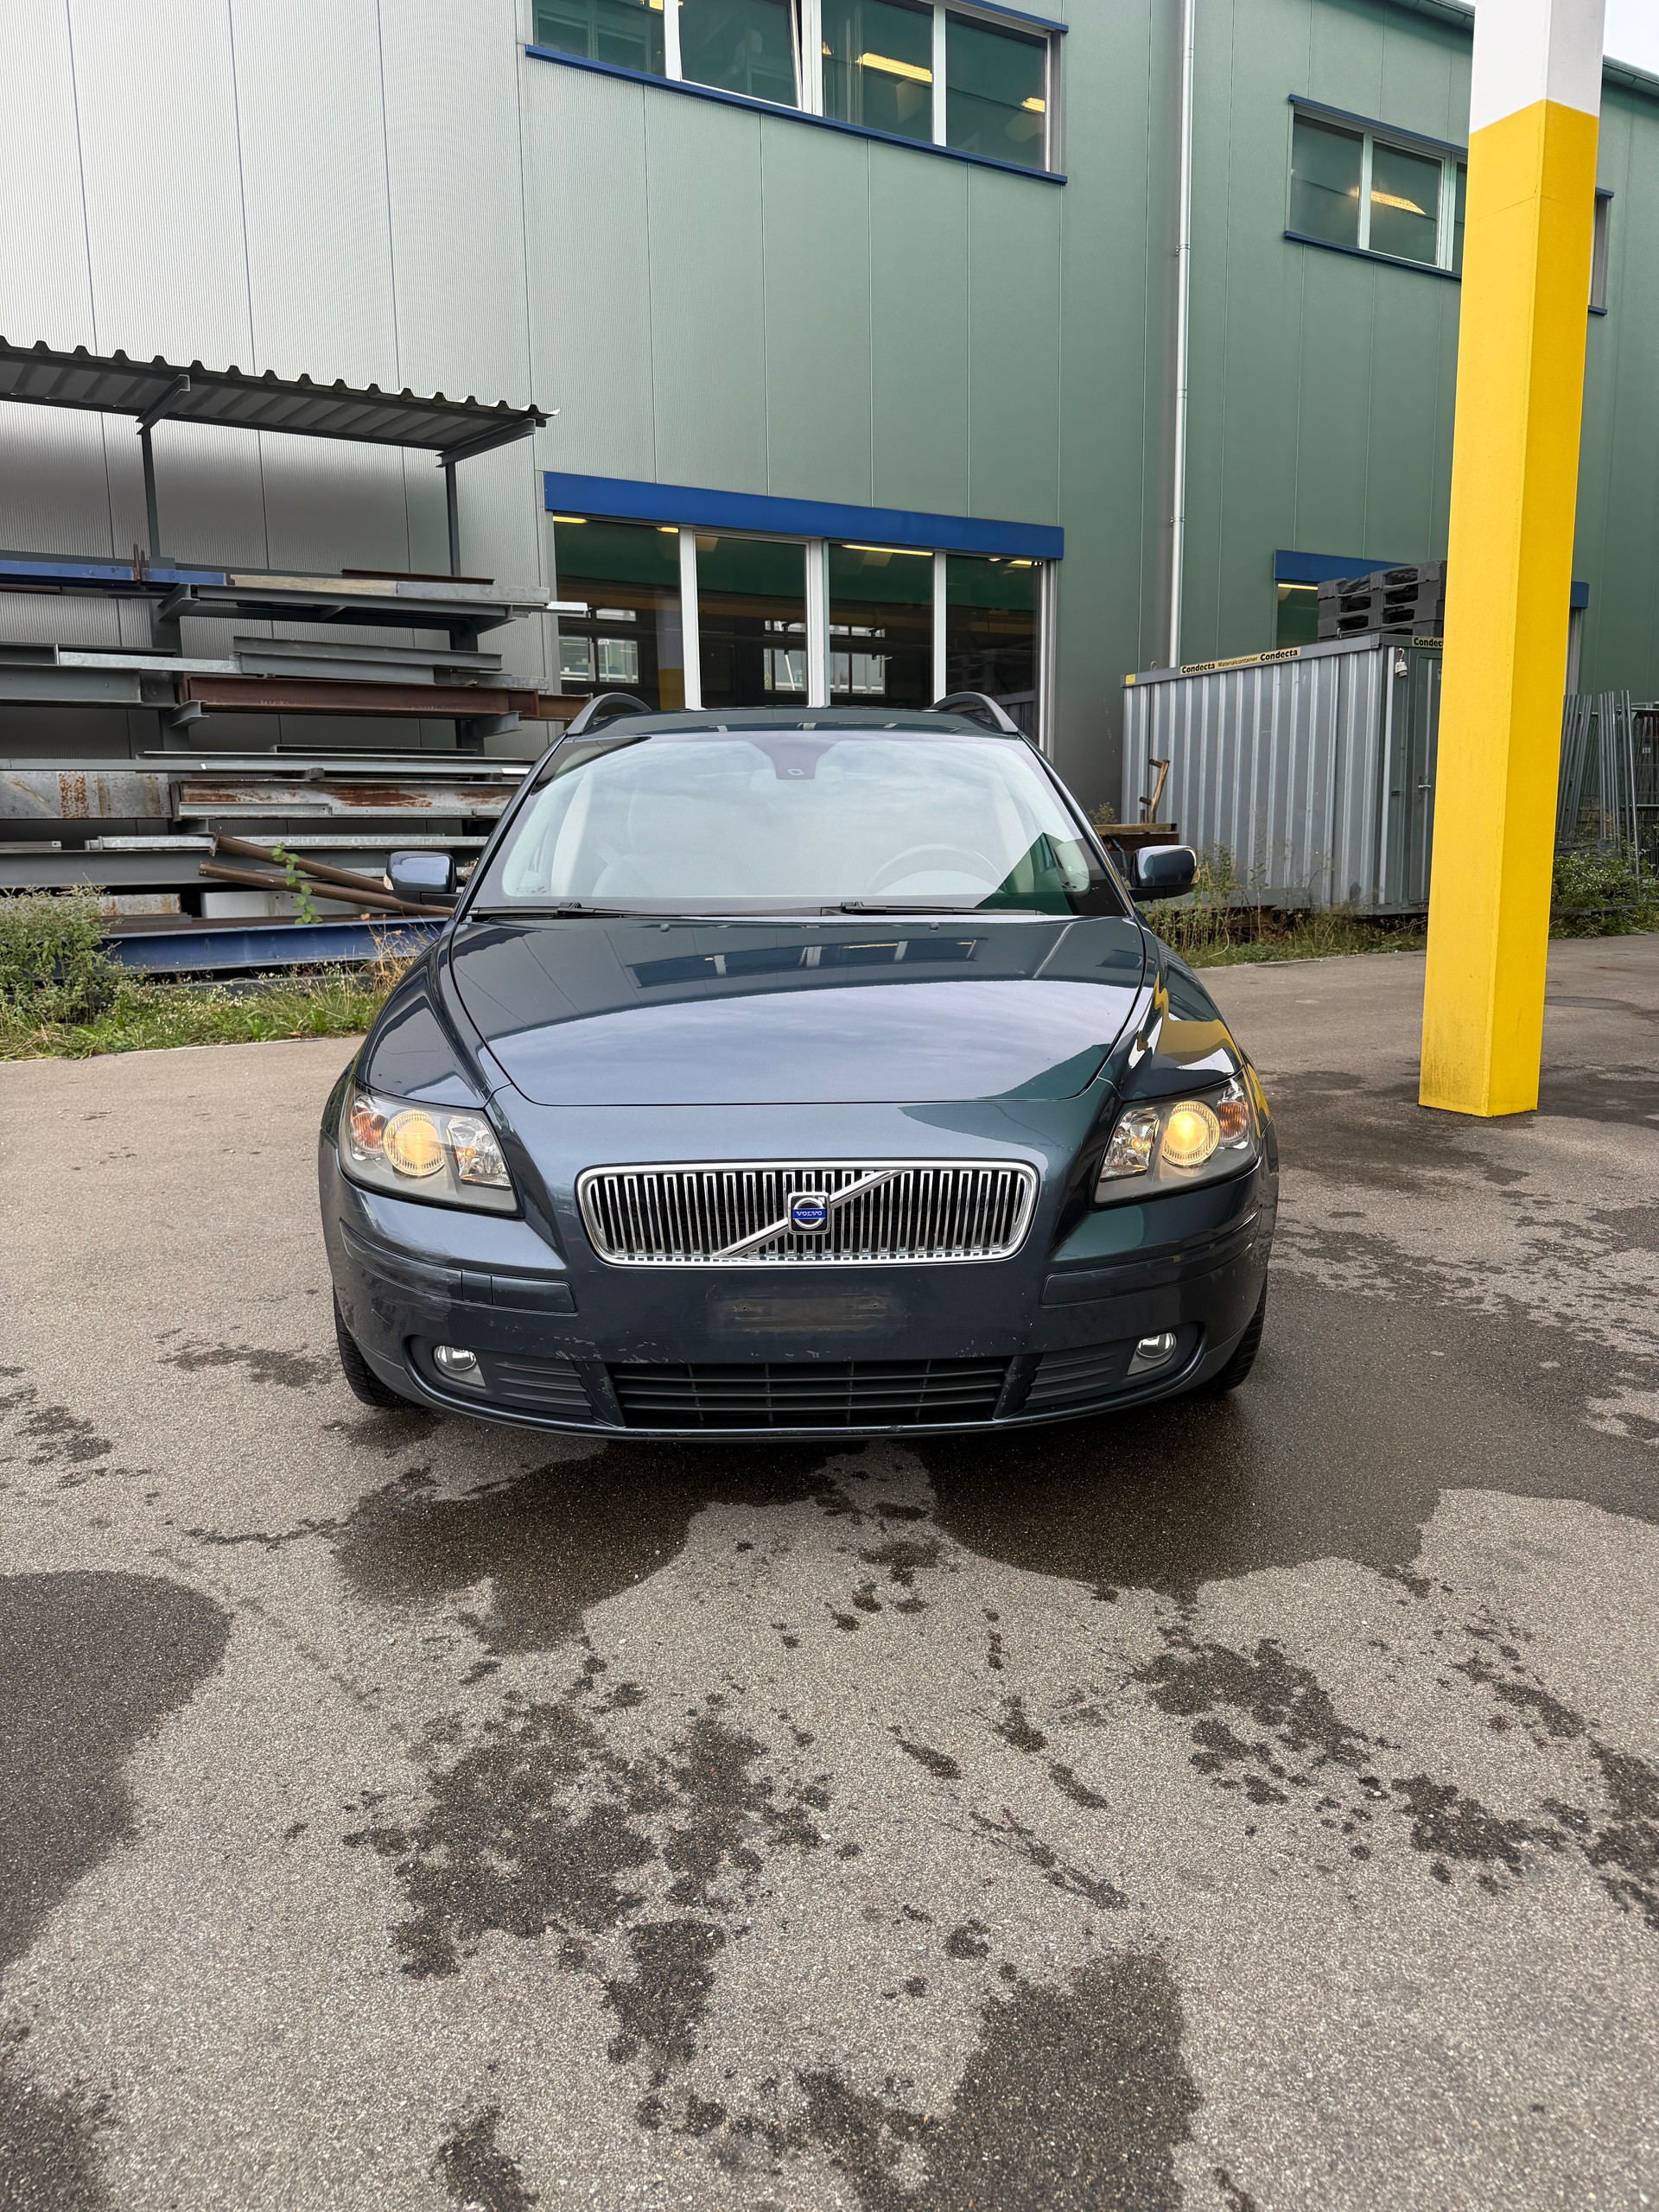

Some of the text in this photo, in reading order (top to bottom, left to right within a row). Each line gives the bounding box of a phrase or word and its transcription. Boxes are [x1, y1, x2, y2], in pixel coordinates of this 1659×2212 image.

[1414, 638, 1443, 647] Condec
[1181, 649, 1298, 674] Condecta Materialcontainer Condecta
